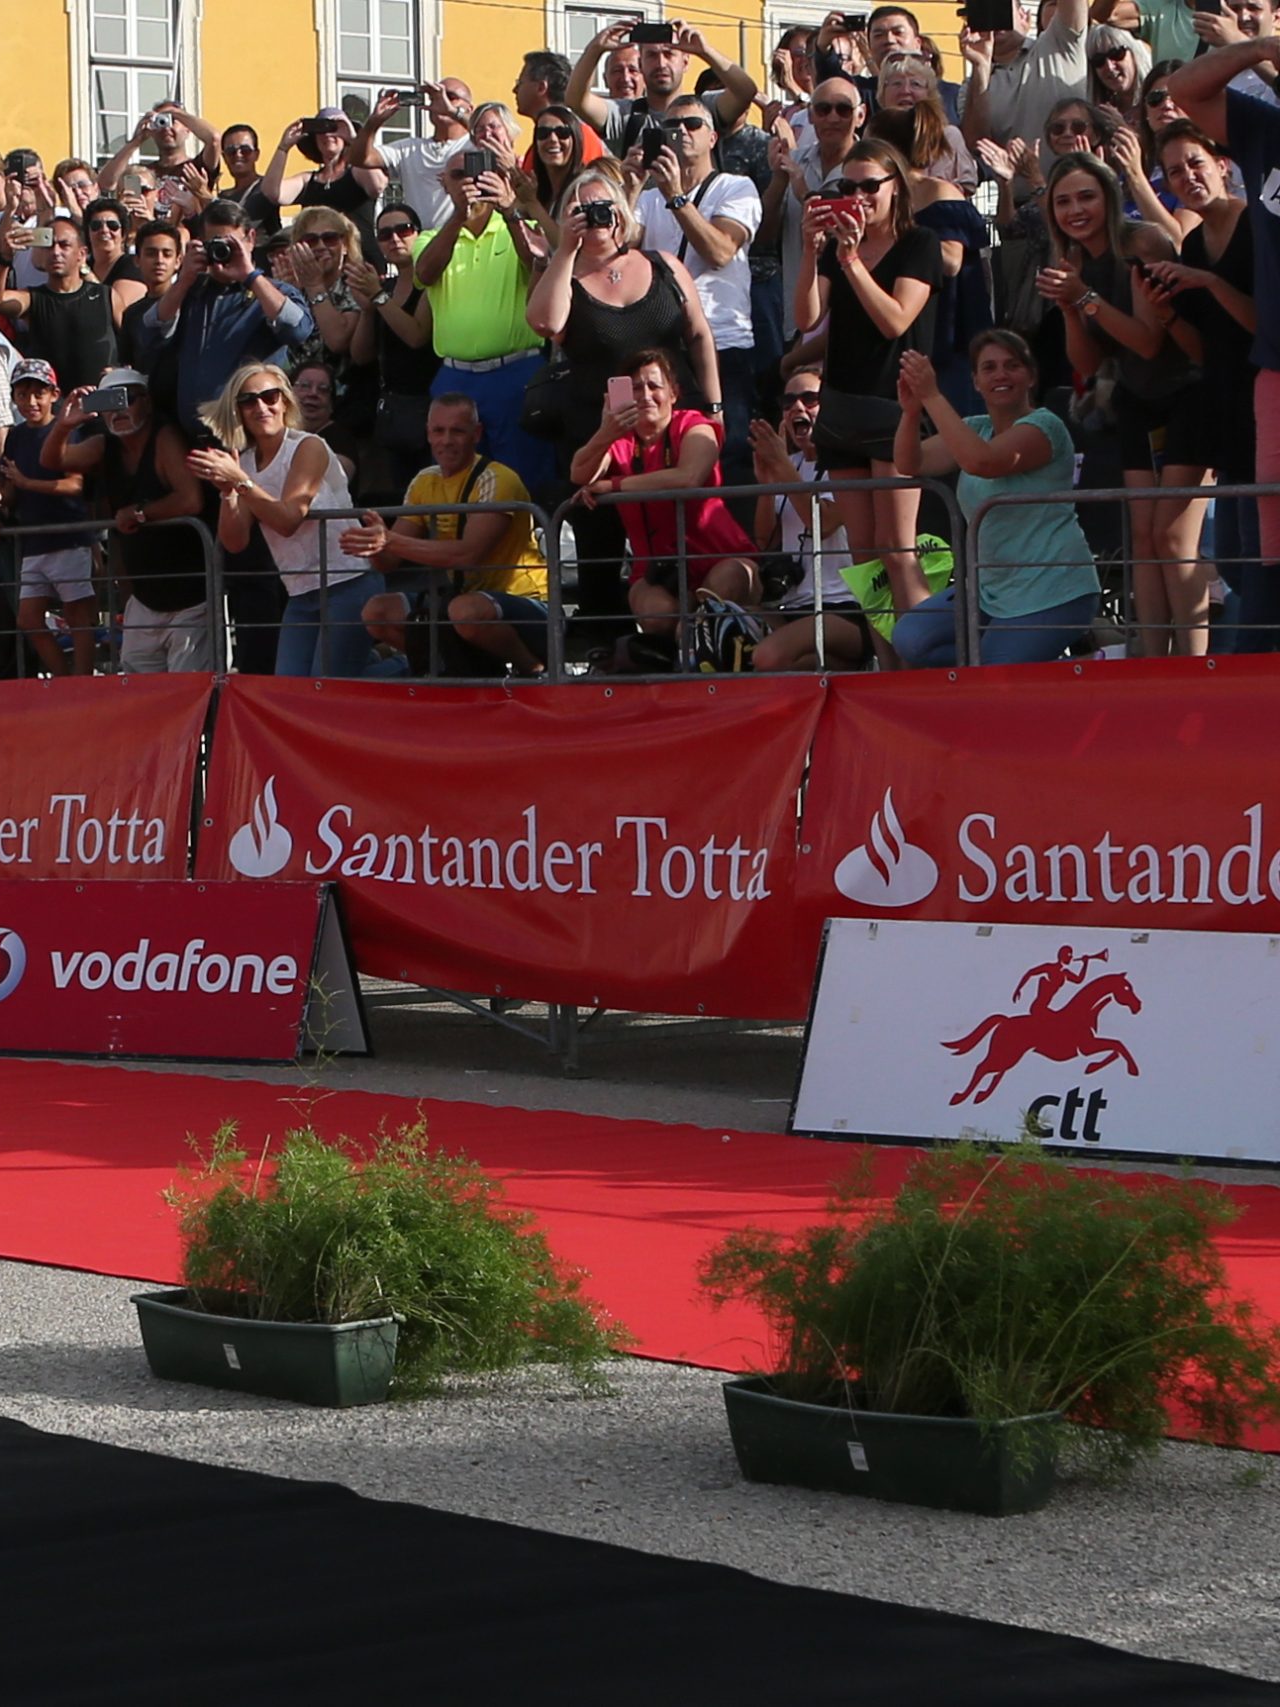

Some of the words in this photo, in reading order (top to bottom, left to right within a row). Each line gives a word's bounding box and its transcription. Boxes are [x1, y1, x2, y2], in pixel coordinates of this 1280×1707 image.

[49, 794, 165, 864] Totta
[305, 804, 603, 893] Santander
[616, 816, 771, 901] Totta
[958, 803, 1280, 905] Santand
[51, 939, 297, 994] vodafone
[1026, 1087, 1108, 1142] ctt
